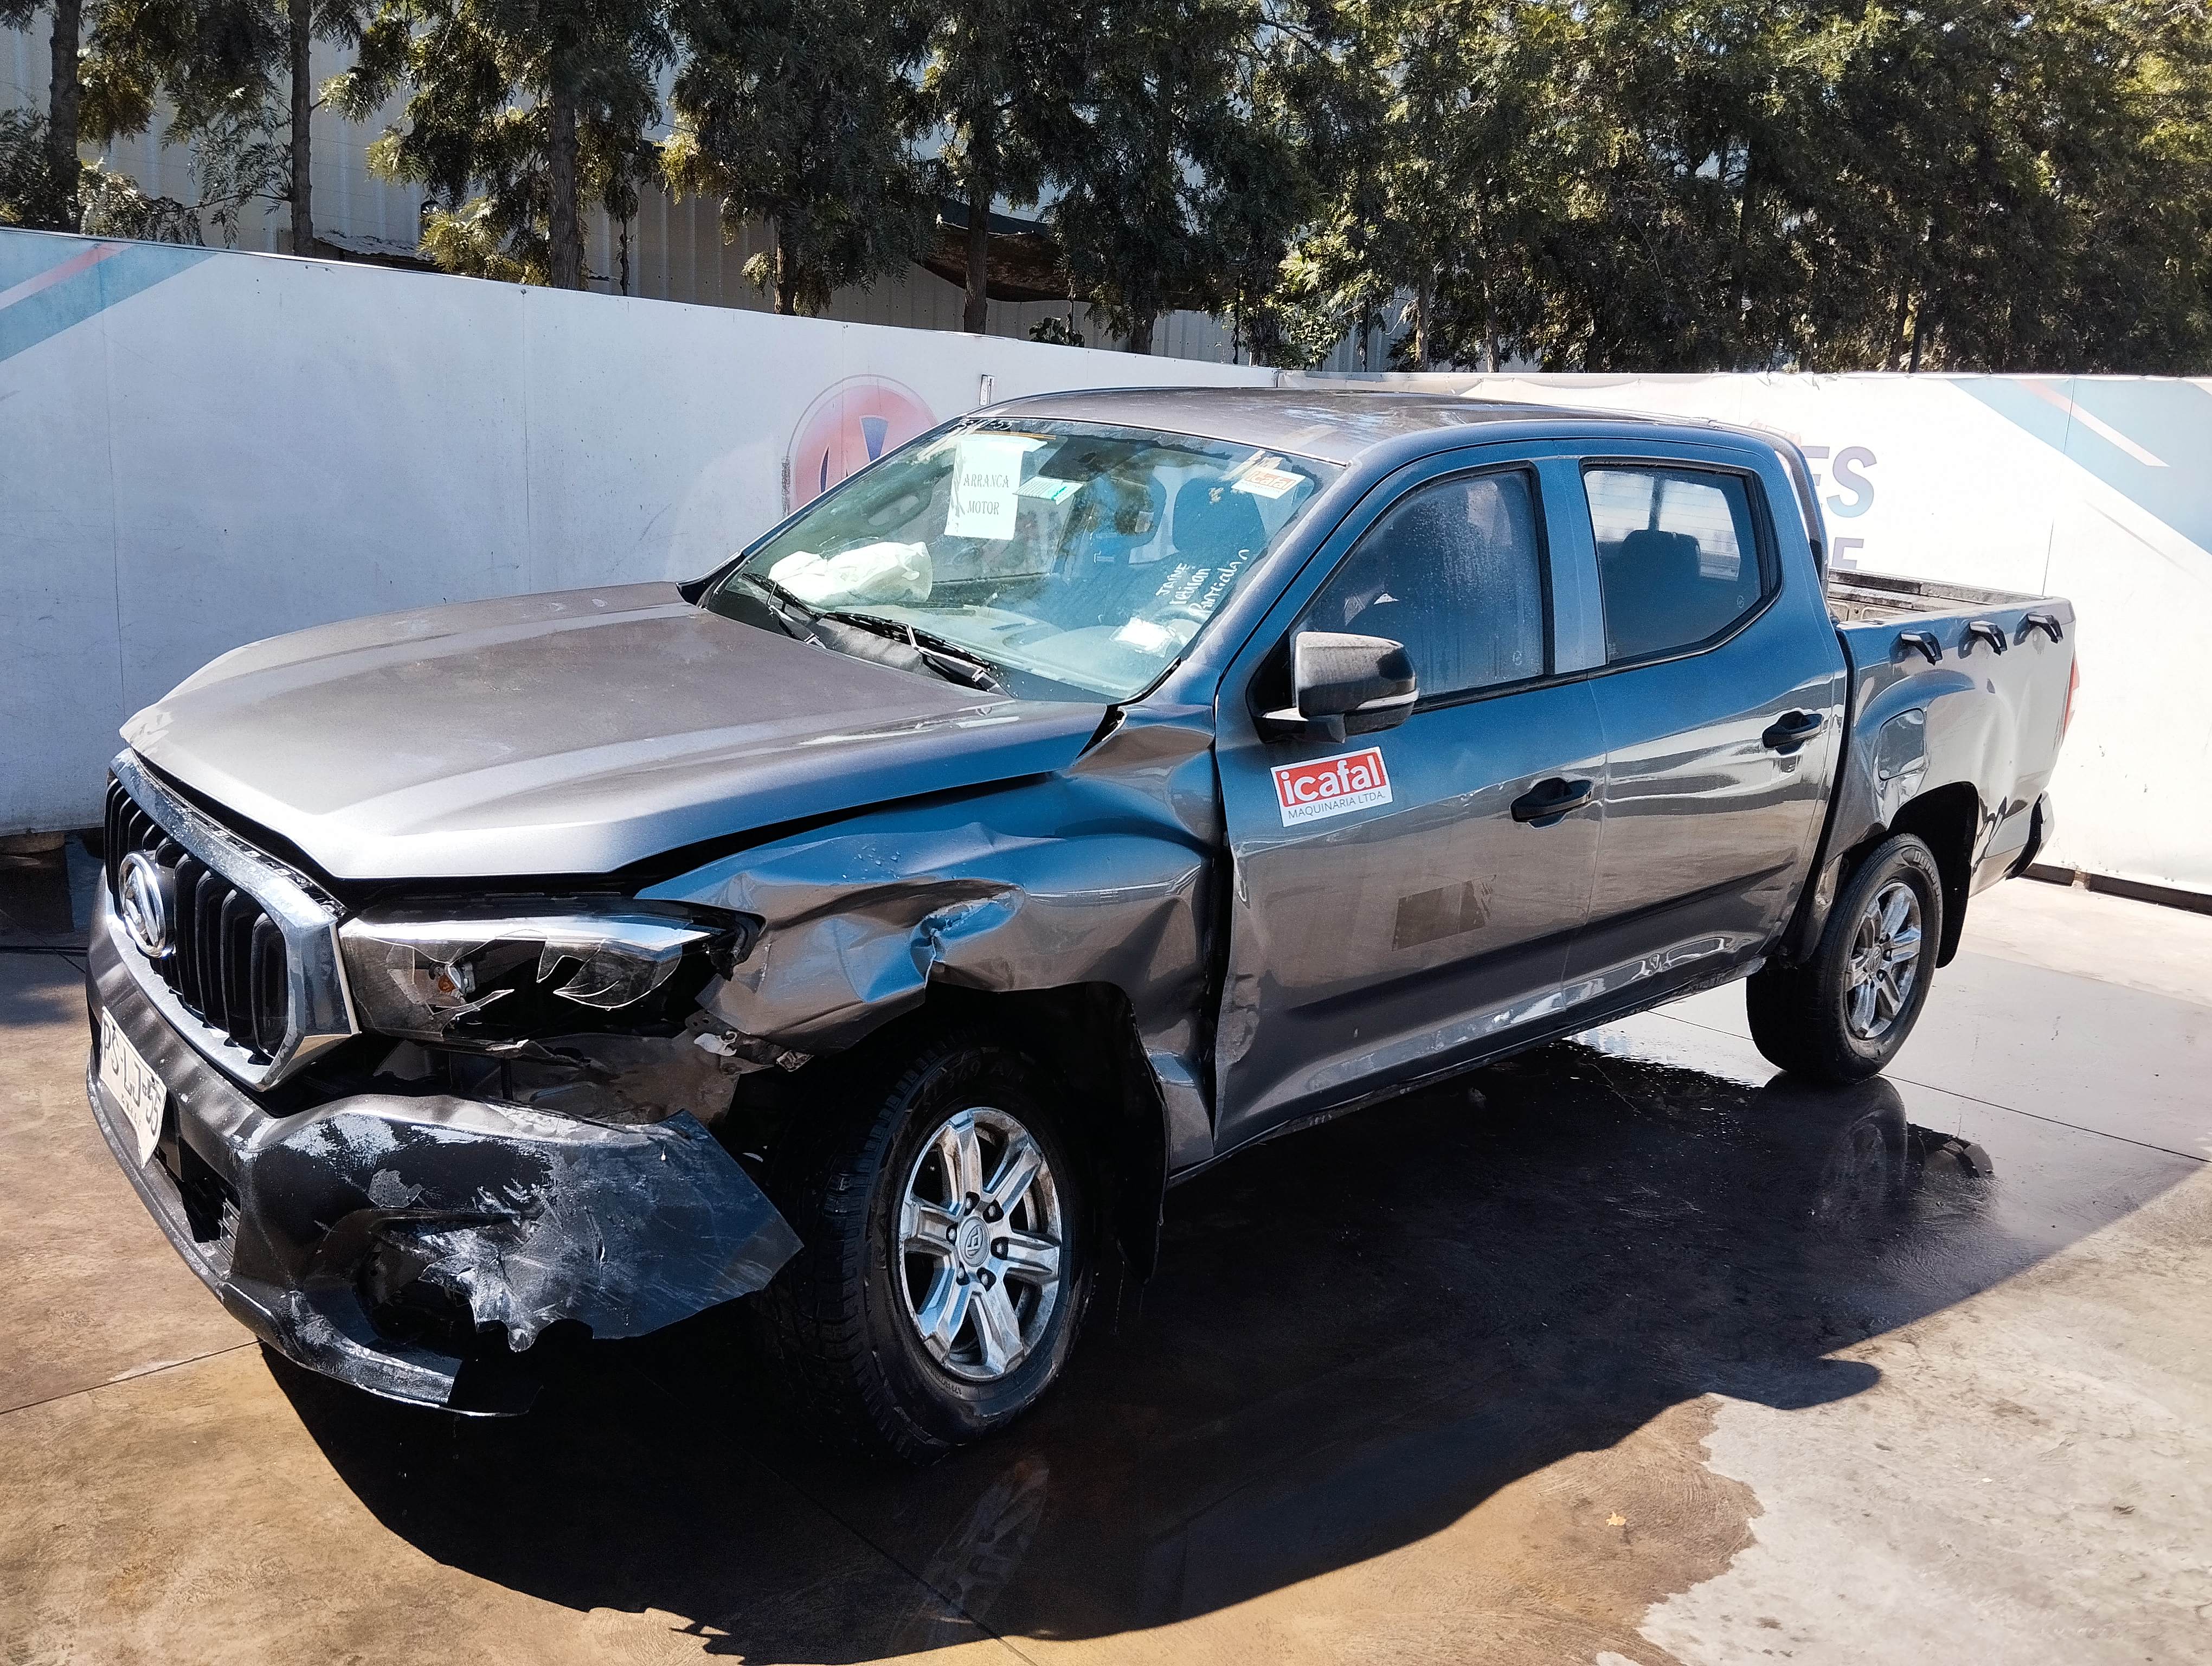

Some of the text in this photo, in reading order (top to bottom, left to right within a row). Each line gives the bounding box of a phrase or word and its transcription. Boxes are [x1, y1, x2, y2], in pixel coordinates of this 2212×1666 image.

[963, 473, 1009, 488] ARRANCA
[967, 501, 1000, 515] MOTOR
[1281, 755, 1381, 804] icafal
[1288, 791, 1385, 819] MAQUINARIA LTDA.
